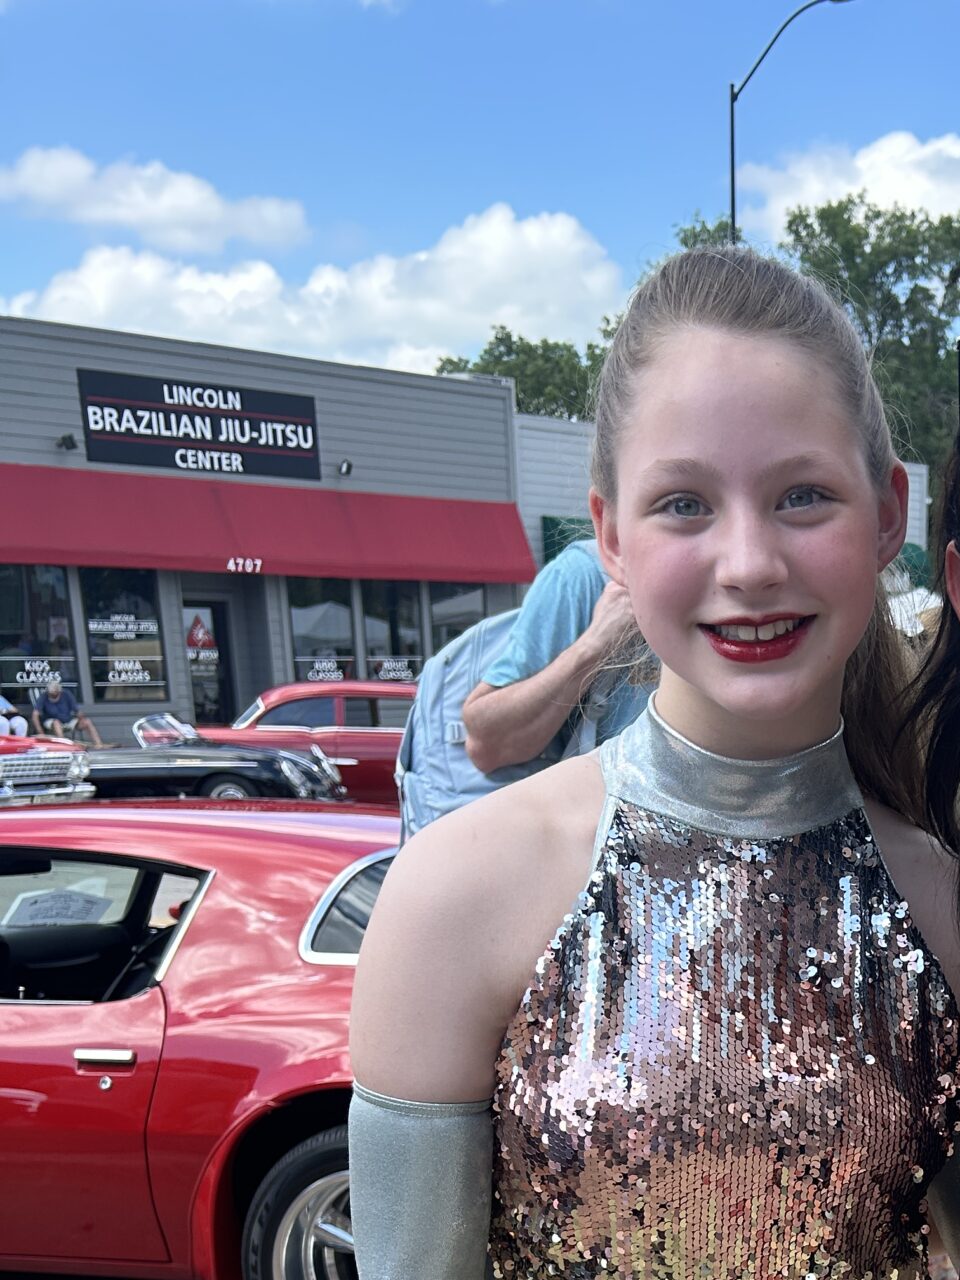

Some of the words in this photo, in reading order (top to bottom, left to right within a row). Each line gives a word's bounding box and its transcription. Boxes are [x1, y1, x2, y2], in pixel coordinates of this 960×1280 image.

[162, 383, 242, 411] LINCOLN
[87, 405, 213, 441] BRAZILIAN
[218, 417, 314, 449] JIU-JITSU
[174, 448, 244, 473] CENTER
[226, 557, 263, 573] 4707
[24, 660, 51, 672] KIDS
[113, 660, 142, 671] MMA
[16, 671, 62, 683] CLASSES
[108, 670, 151, 682] CLASSES
